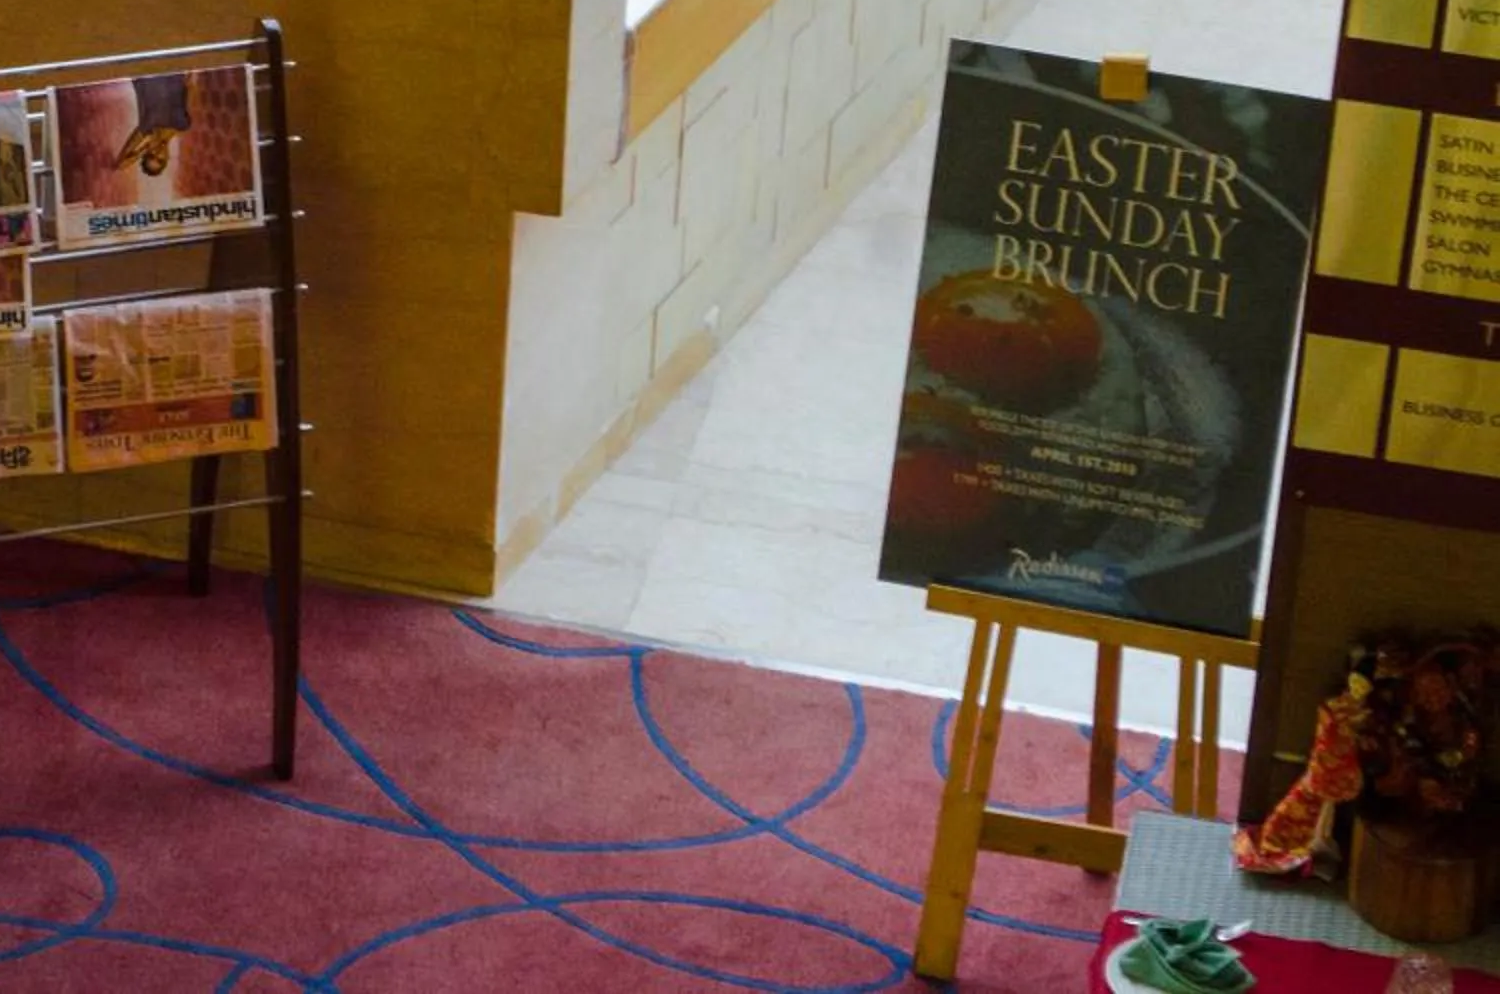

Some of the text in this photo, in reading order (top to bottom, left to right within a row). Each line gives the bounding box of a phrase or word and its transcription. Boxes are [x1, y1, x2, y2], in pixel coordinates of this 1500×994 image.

[1006, 120, 1243, 210] EASTER
[1439, 133, 1495, 155] SATIN
[994, 179, 1240, 261] SUNDAY
[1433, 185, 1471, 205] THE
[992, 235, 1231, 320] BRUNCH
